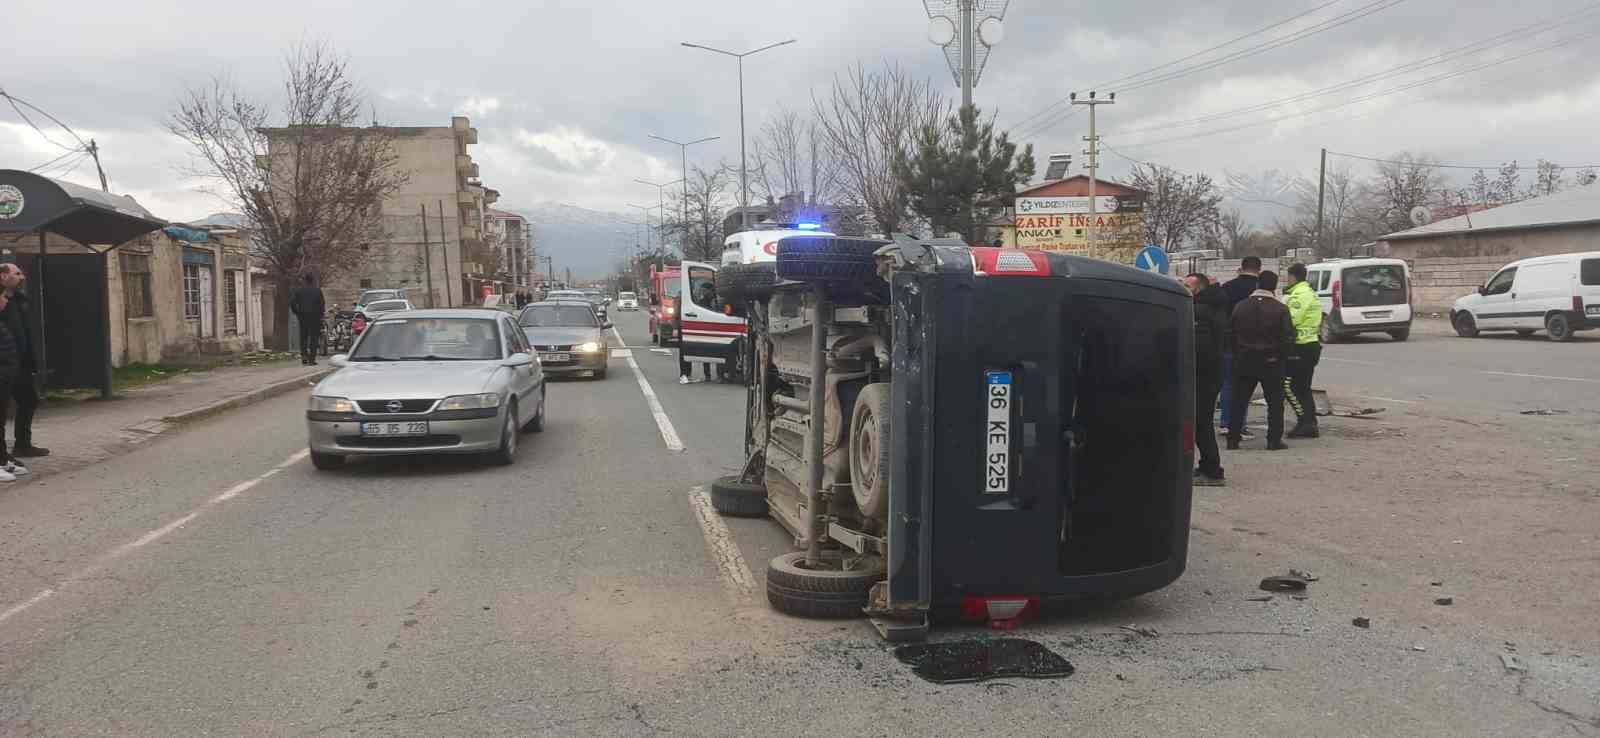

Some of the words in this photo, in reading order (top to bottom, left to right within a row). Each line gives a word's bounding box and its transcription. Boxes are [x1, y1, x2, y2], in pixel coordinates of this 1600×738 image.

[1016, 213, 1064, 229] ZARİF
[1016, 229, 1055, 238] ANKA
[990, 386, 1008, 409] 36
[989, 421, 1007, 445] KE
[988, 453, 1006, 489] 525
